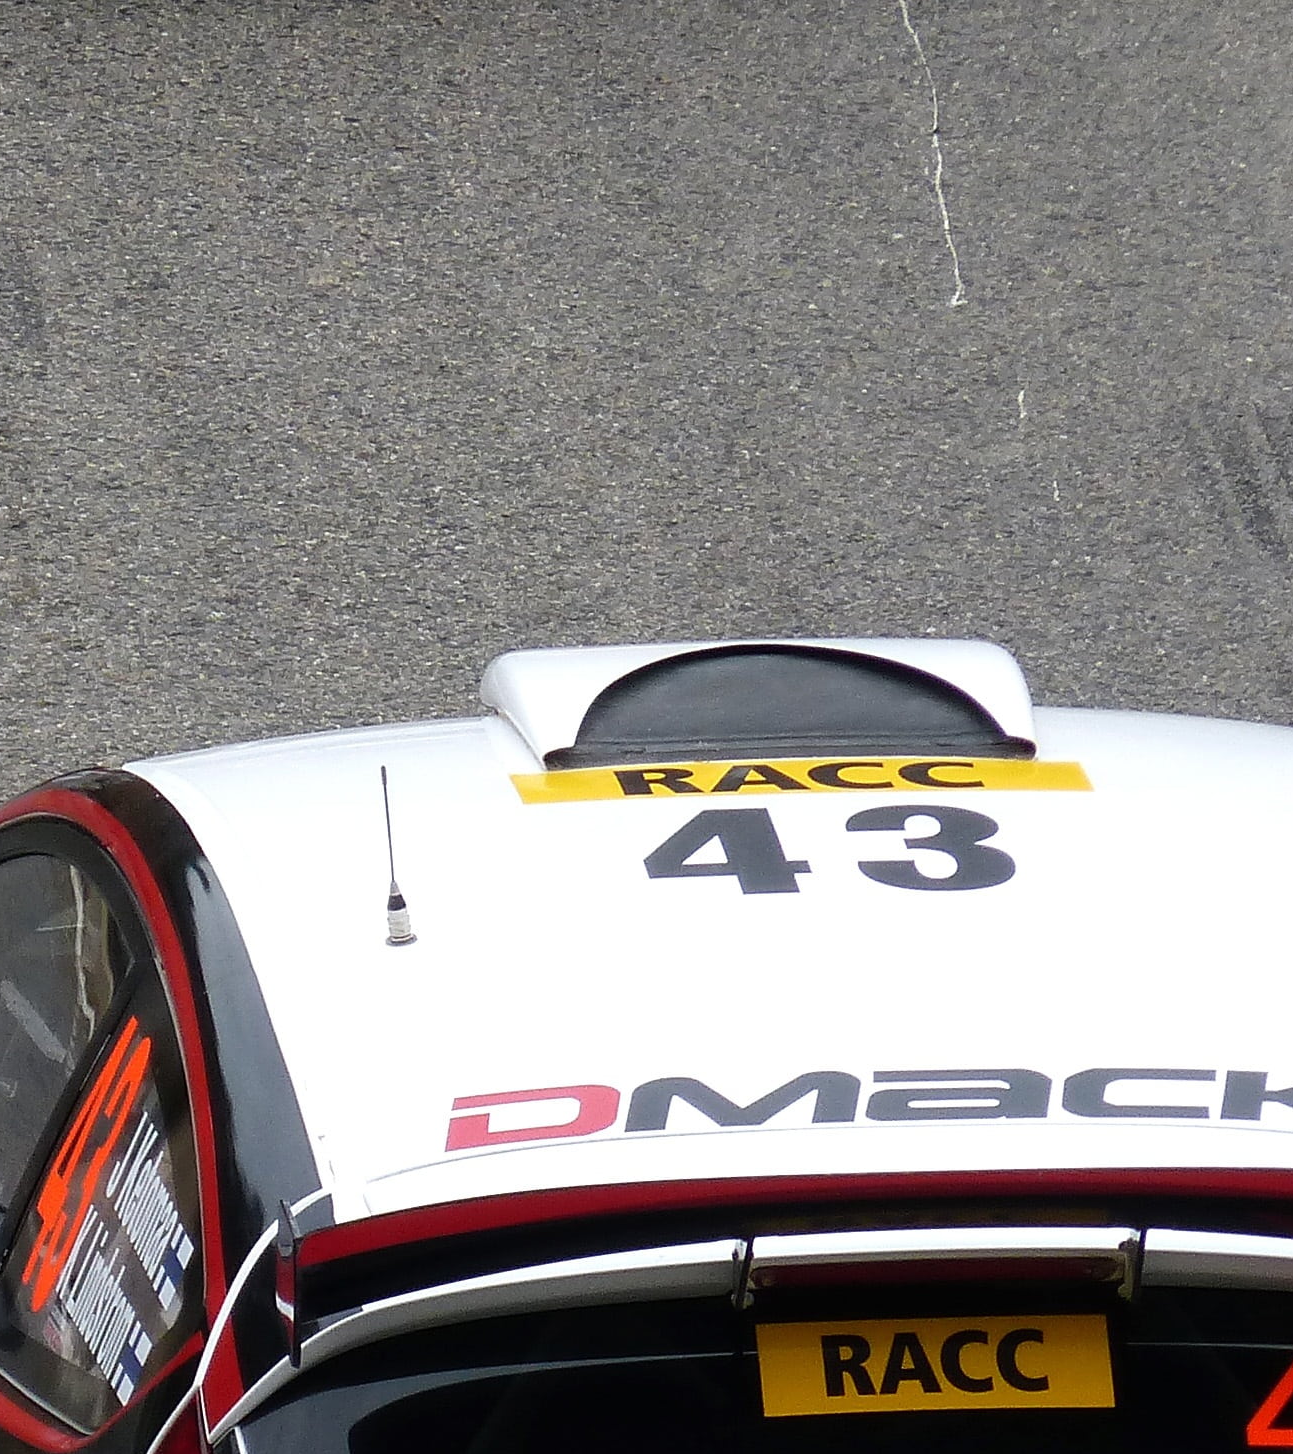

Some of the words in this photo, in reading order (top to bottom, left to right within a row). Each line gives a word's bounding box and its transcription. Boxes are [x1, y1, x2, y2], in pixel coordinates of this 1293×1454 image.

[614, 761, 985, 796] RACC
[643, 804, 1016, 895] 43
[22, 1016, 152, 1313] 43
[114, 1120, 179, 1281] Ketomaa
[819, 1328, 1050, 1398] RACC
